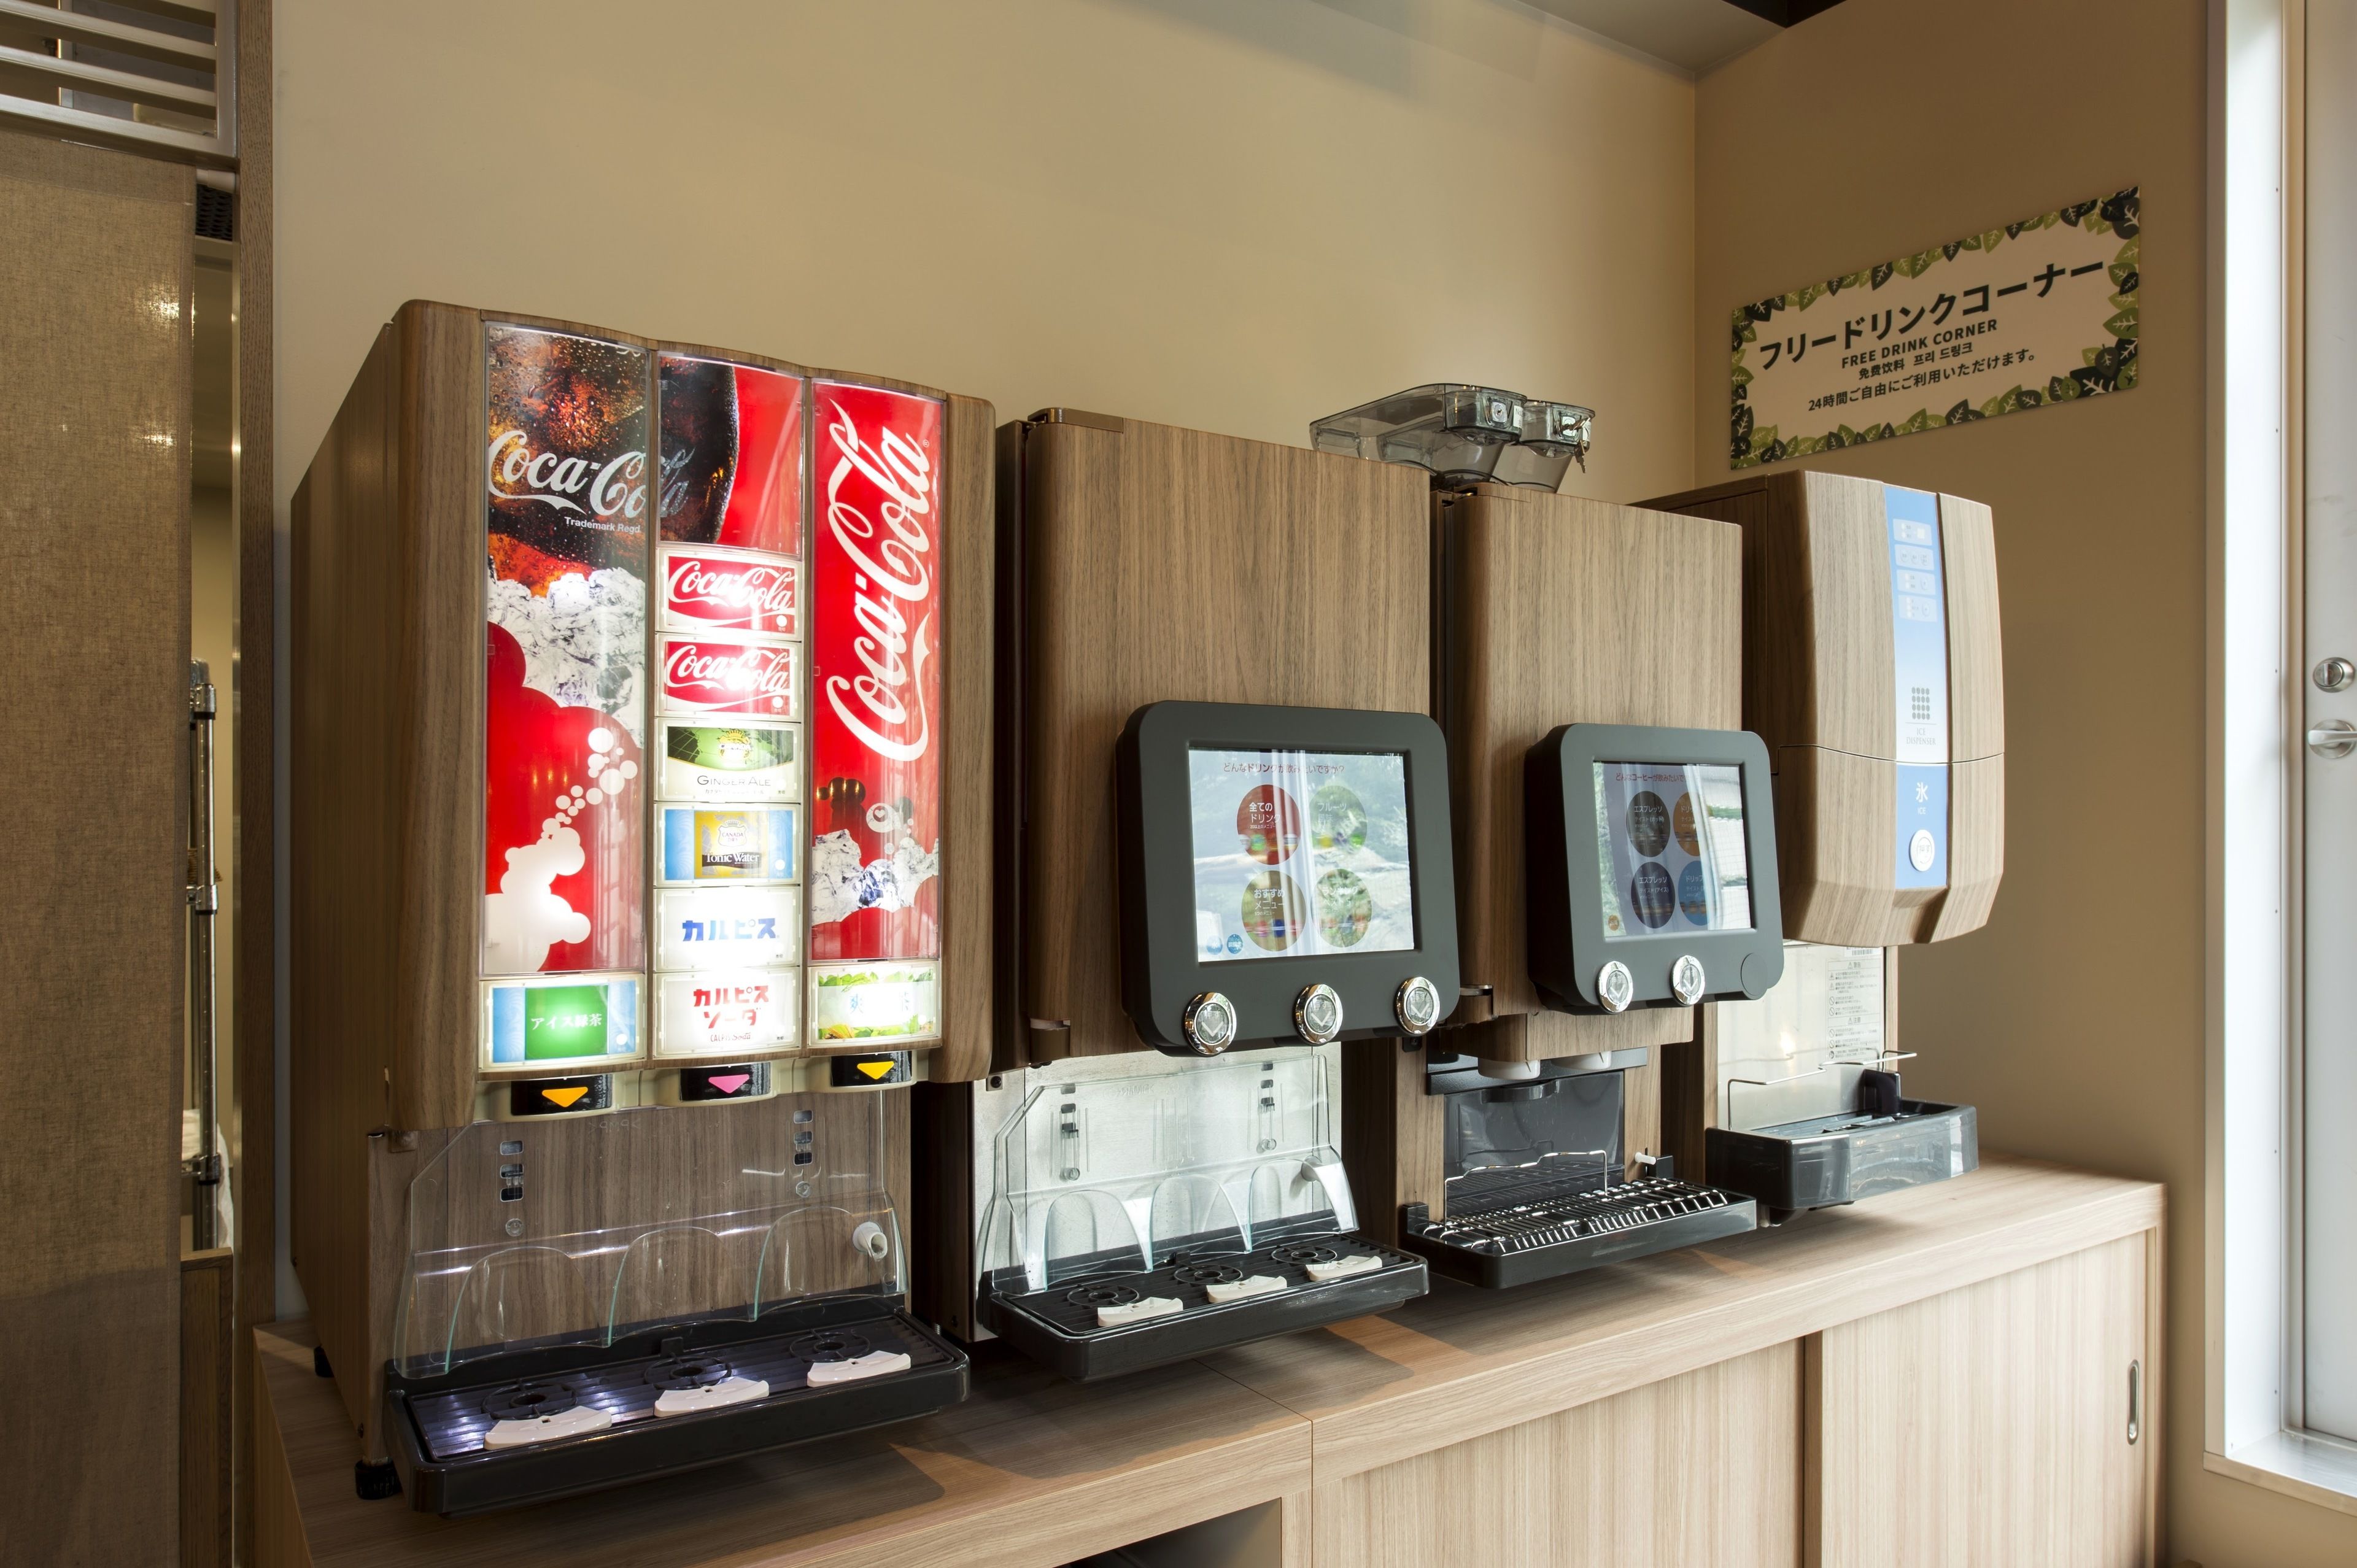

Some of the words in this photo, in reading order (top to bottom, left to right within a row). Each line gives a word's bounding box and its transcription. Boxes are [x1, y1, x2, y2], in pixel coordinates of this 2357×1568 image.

[1760, 261, 2103, 370] フリードリンクコーナー
[1841, 350, 1876, 369] FREE
[1881, 337, 1928, 359] DRINK
[1933, 319, 1997, 346] CORNER
[1913, 350, 1935, 366] 프리
[1939, 342, 1973, 360] 드링크
[1808, 349, 2035, 411] 24時間ご自由にご利用いただけます。
[1859, 358, 1905, 380] 免费饮料
[564, 516, 615, 531] Trademark
[668, 561, 795, 611] Coca-Cola
[826, 398, 930, 762] Coca-Cola
[664, 645, 791, 693] Coca-Cola
[1906, 736, 1936, 746] DISPENSER
[1916, 727, 1926, 736] ICE
[1916, 781, 1929, 803] 氷
[1248, 801, 1273, 812] 全ての
[1317, 802, 1347, 811] フルーツ
[1250, 813, 1281, 824] ドリンク
[733, 852, 760, 862] Water
[1253, 889, 1285, 898] おすすめ
[682, 917, 776, 941] カルピス
[693, 985, 769, 1007] カルピス
[531, 1013, 603, 1030] アイス緑茶
[703, 1007, 761, 1029] ソーダ
